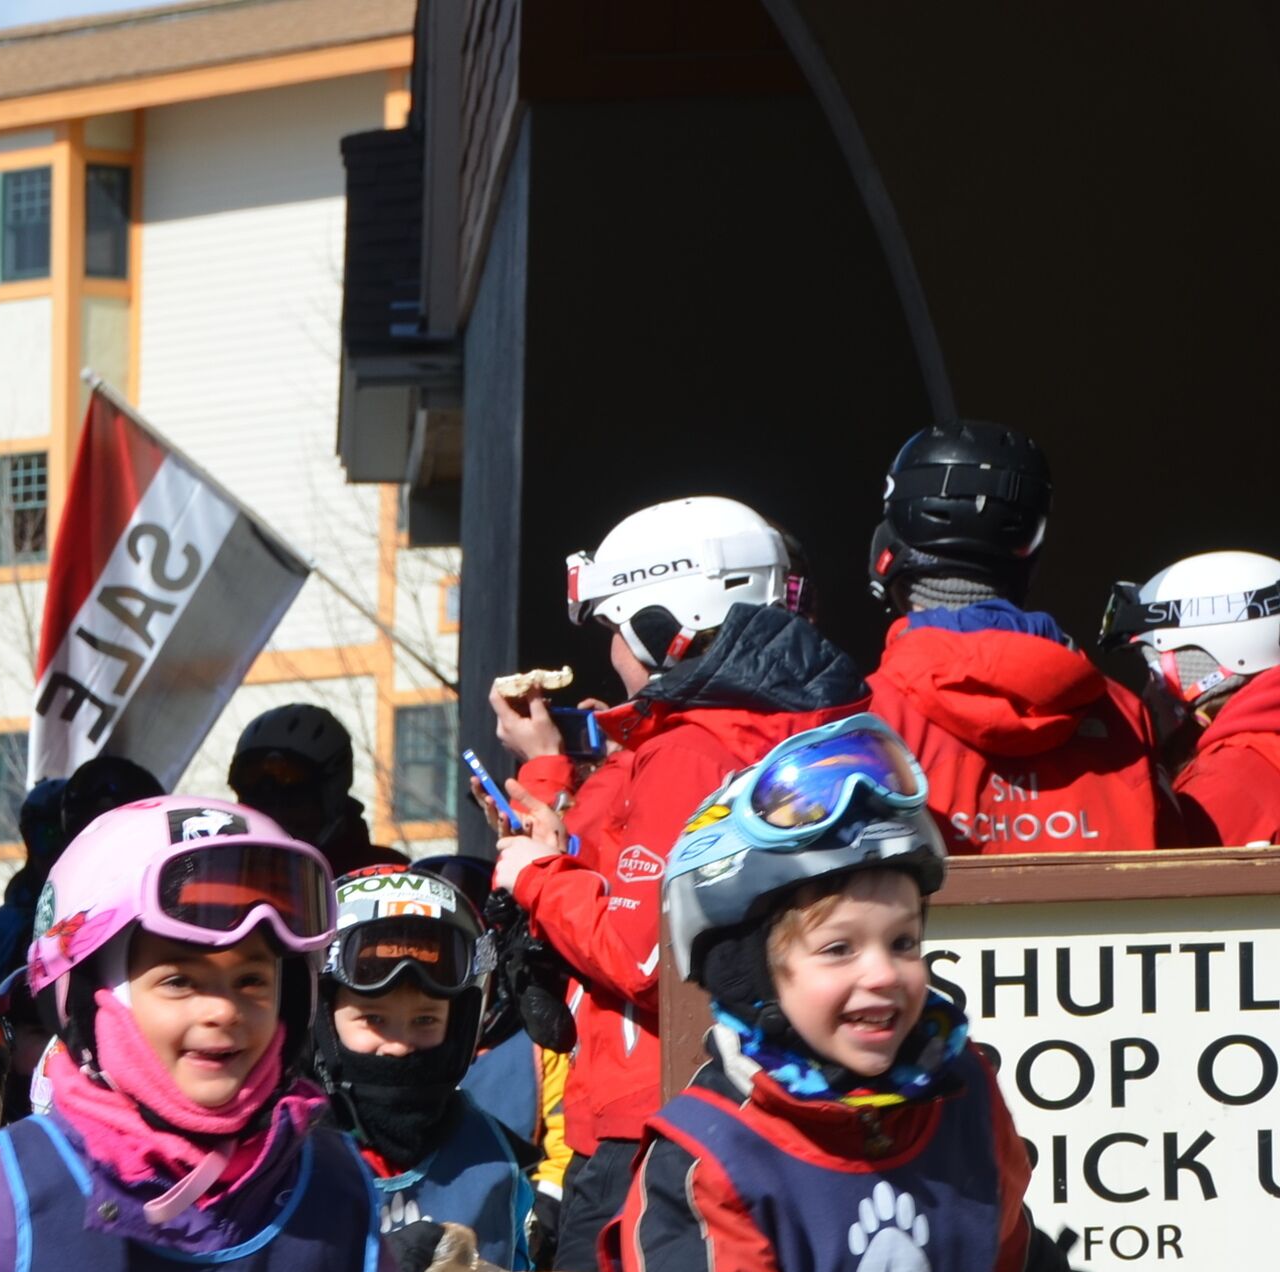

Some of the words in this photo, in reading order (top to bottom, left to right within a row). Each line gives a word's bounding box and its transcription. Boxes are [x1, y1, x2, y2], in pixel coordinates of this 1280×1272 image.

[991, 772, 1038, 802] SKI
[951, 810, 1099, 842] SCHOOL
[920, 941, 1280, 1018] SHUTTL
[1083, 1223, 1185, 1262] FOR
